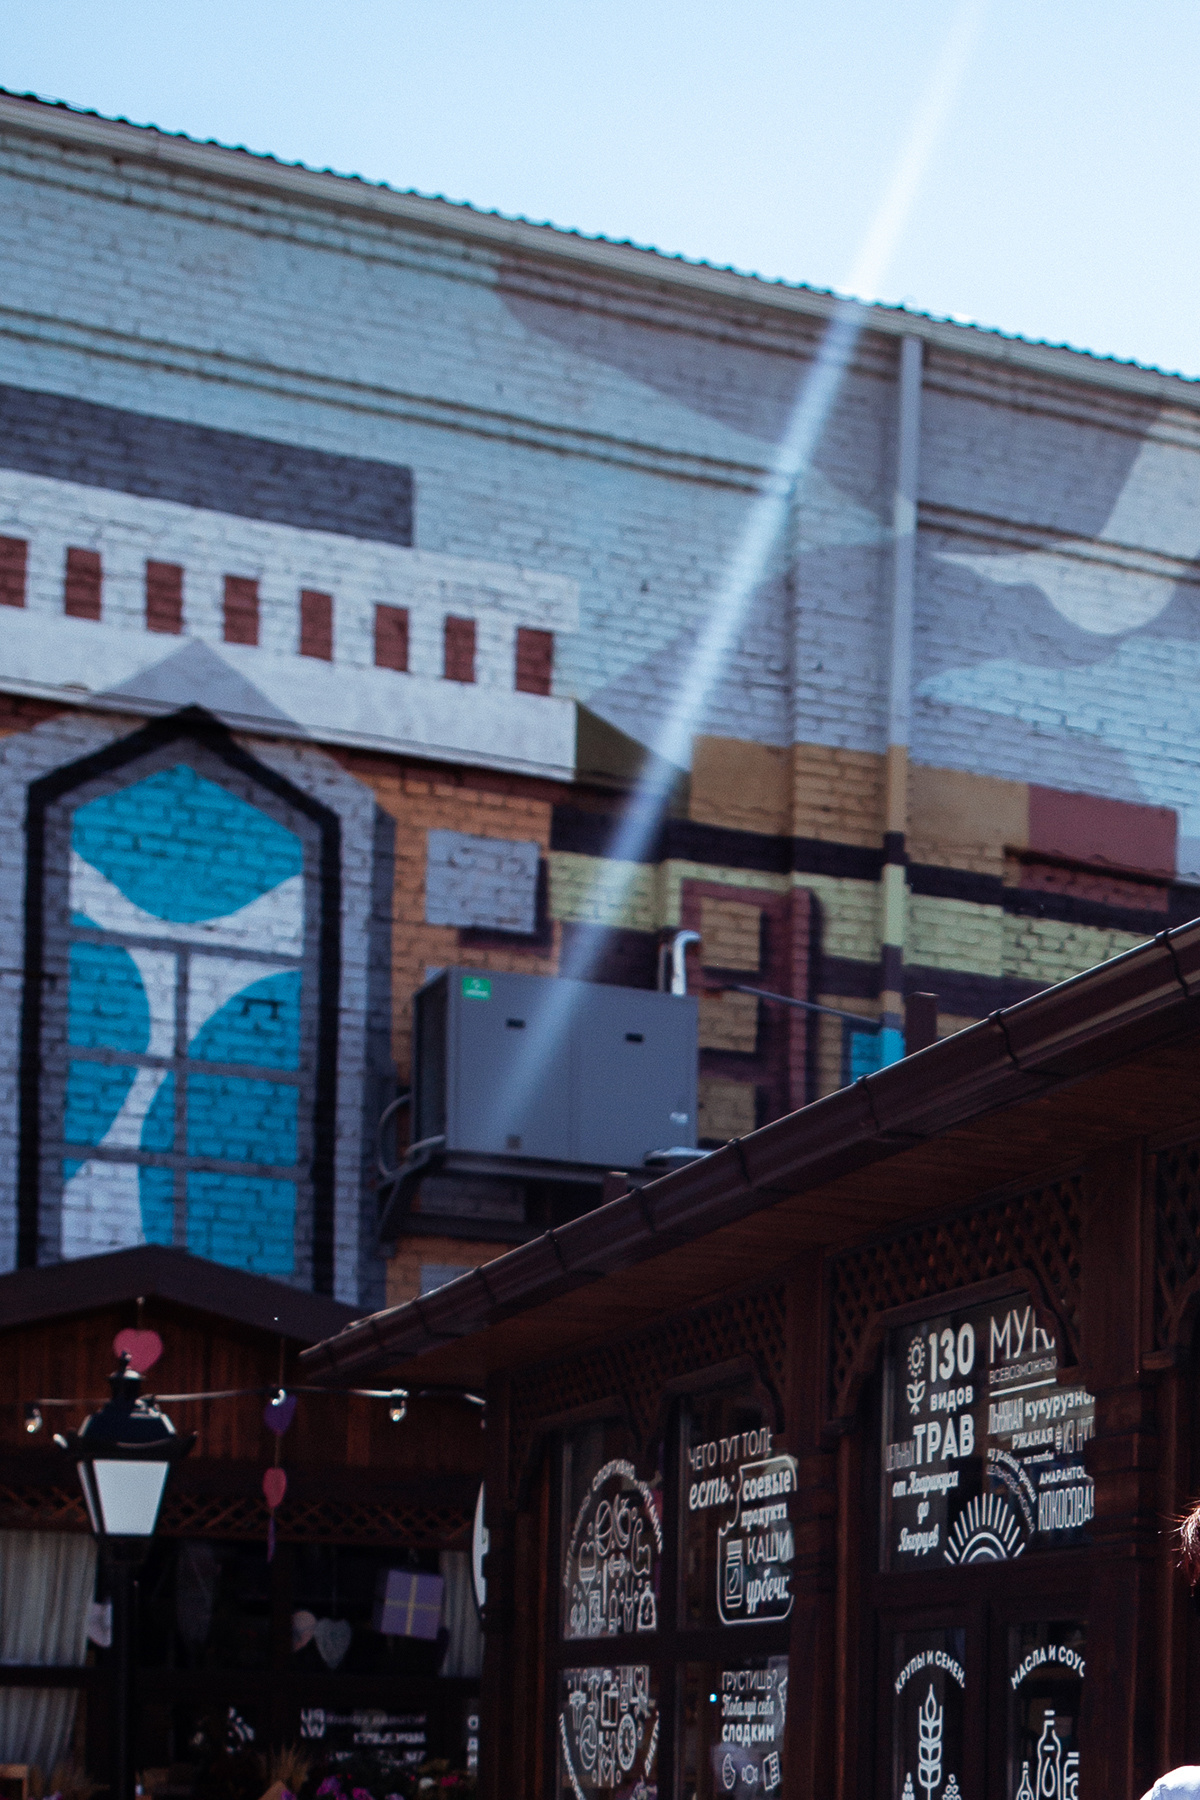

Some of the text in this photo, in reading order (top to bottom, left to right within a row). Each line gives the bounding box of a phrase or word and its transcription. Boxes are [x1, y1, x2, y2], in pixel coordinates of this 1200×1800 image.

[928, 1322, 975, 1383] 130
[989, 1305, 1056, 1364] МУК
[930, 1385, 974, 1413] видов
[1024, 1391, 1095, 1422] кукурузна
[912, 1413, 975, 1465] ТРАВ
[1012, 1427, 1054, 1450] РЖАНАЯ
[742, 1469, 791, 1503] соевые
[746, 1530, 795, 1566] КАШИ
[894, 1650, 966, 1695] КРУПЫ И СЕМЕН
[1010, 1646, 1047, 1691] МАСЛА
[1048, 1644, 1056, 1661] И
[721, 1723, 775, 1748] сладким
